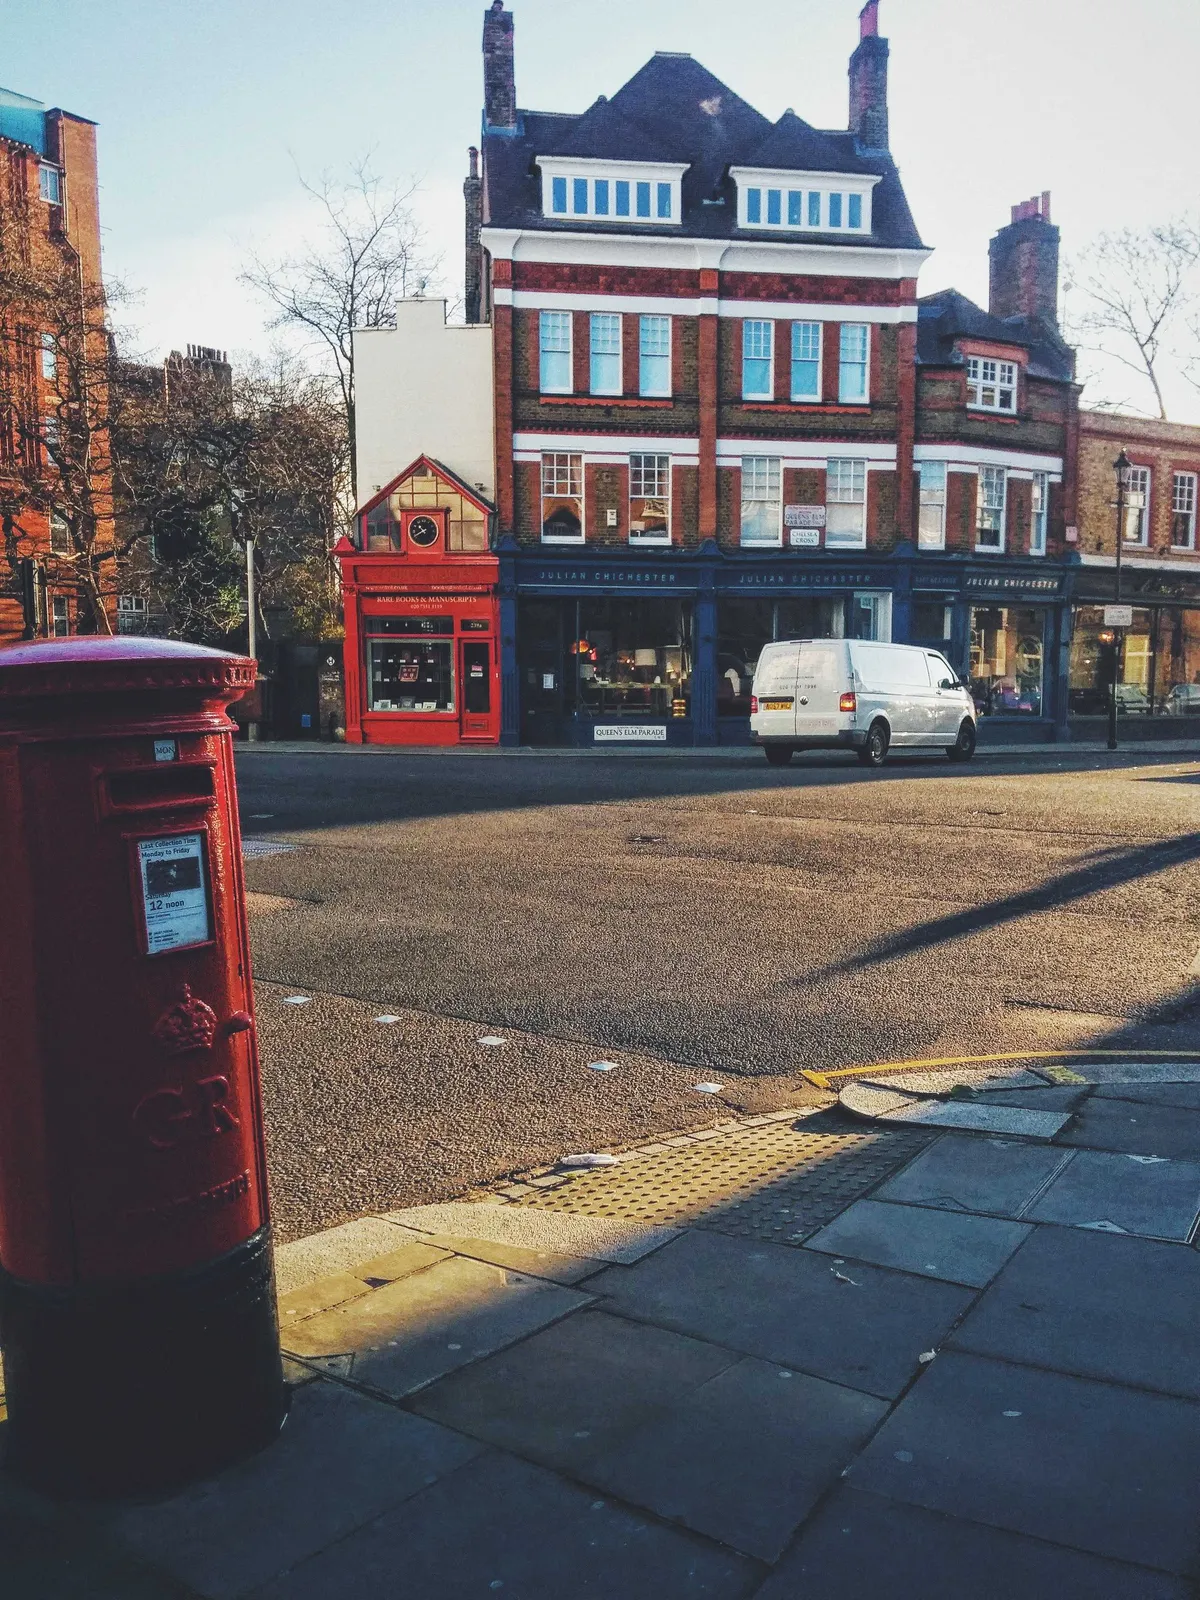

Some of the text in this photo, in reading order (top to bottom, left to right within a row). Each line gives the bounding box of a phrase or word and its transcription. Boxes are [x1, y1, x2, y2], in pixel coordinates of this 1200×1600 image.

[540, 572, 675, 582] JULIAN CHICHESTER
[740, 575, 871, 583] JULIAN CHICHESTER
[966, 577, 1000, 586] JULIAN
[1004, 579, 1059, 588] CHICHESTER
[140, 842, 155, 850] Last
[155, 839, 183, 848] Collection
[141, 850, 164, 859] Monday
[173, 846, 190, 855] Friday
[145, 891, 171, 901] Saturday
[149, 900, 185, 911] 12 noon
